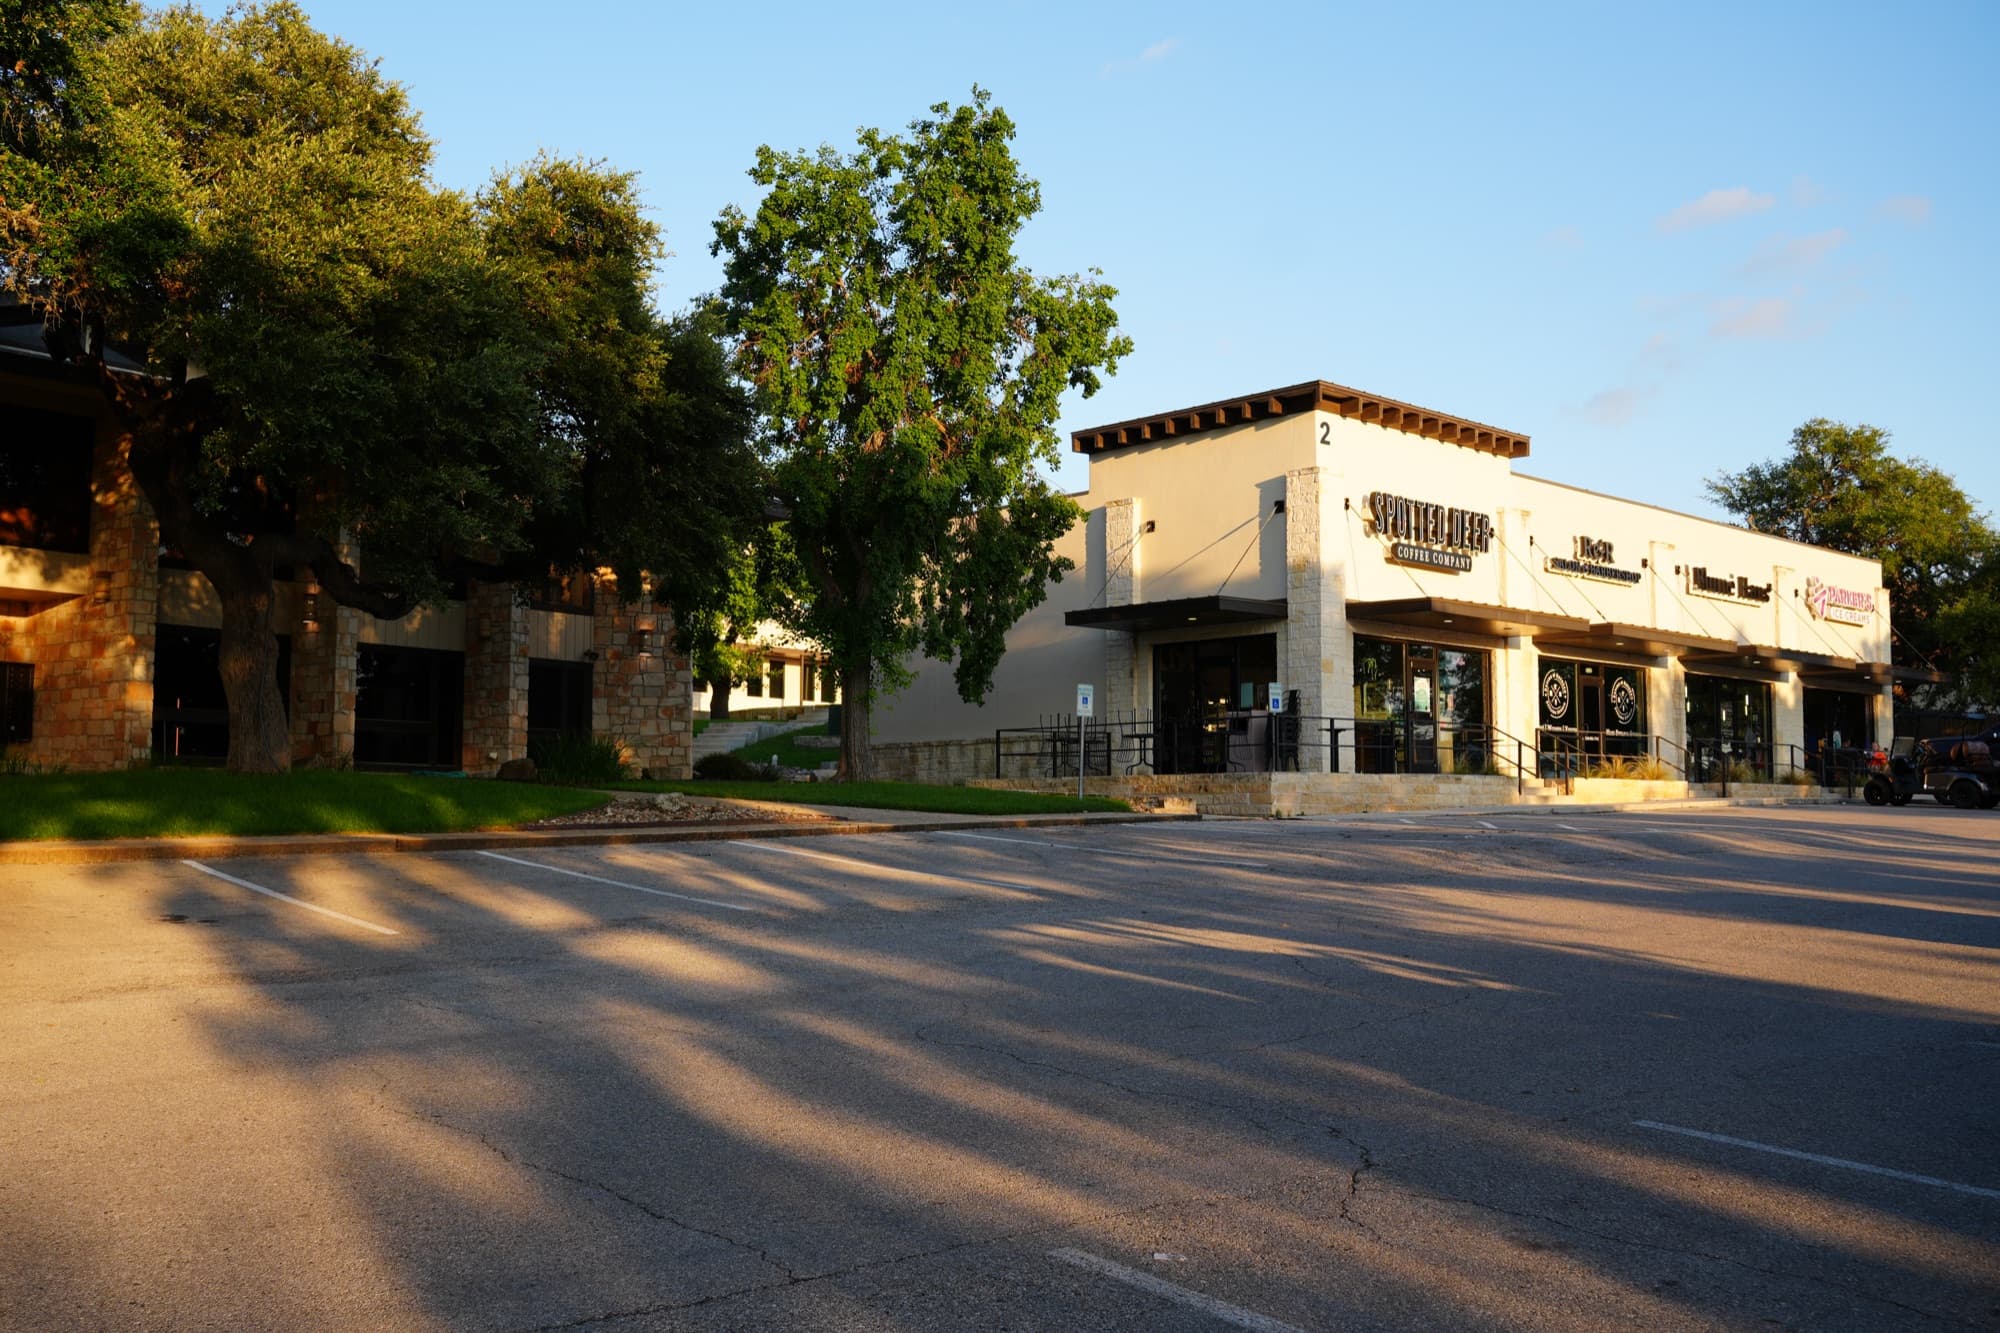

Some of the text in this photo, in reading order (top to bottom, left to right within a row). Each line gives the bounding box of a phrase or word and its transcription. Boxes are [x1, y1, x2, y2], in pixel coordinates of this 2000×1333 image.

[1320, 421, 1330, 446] 2
[1370, 491, 1490, 553] SPOTTED DEER
[1397, 546, 1471, 570] COFFEE COMPANY
